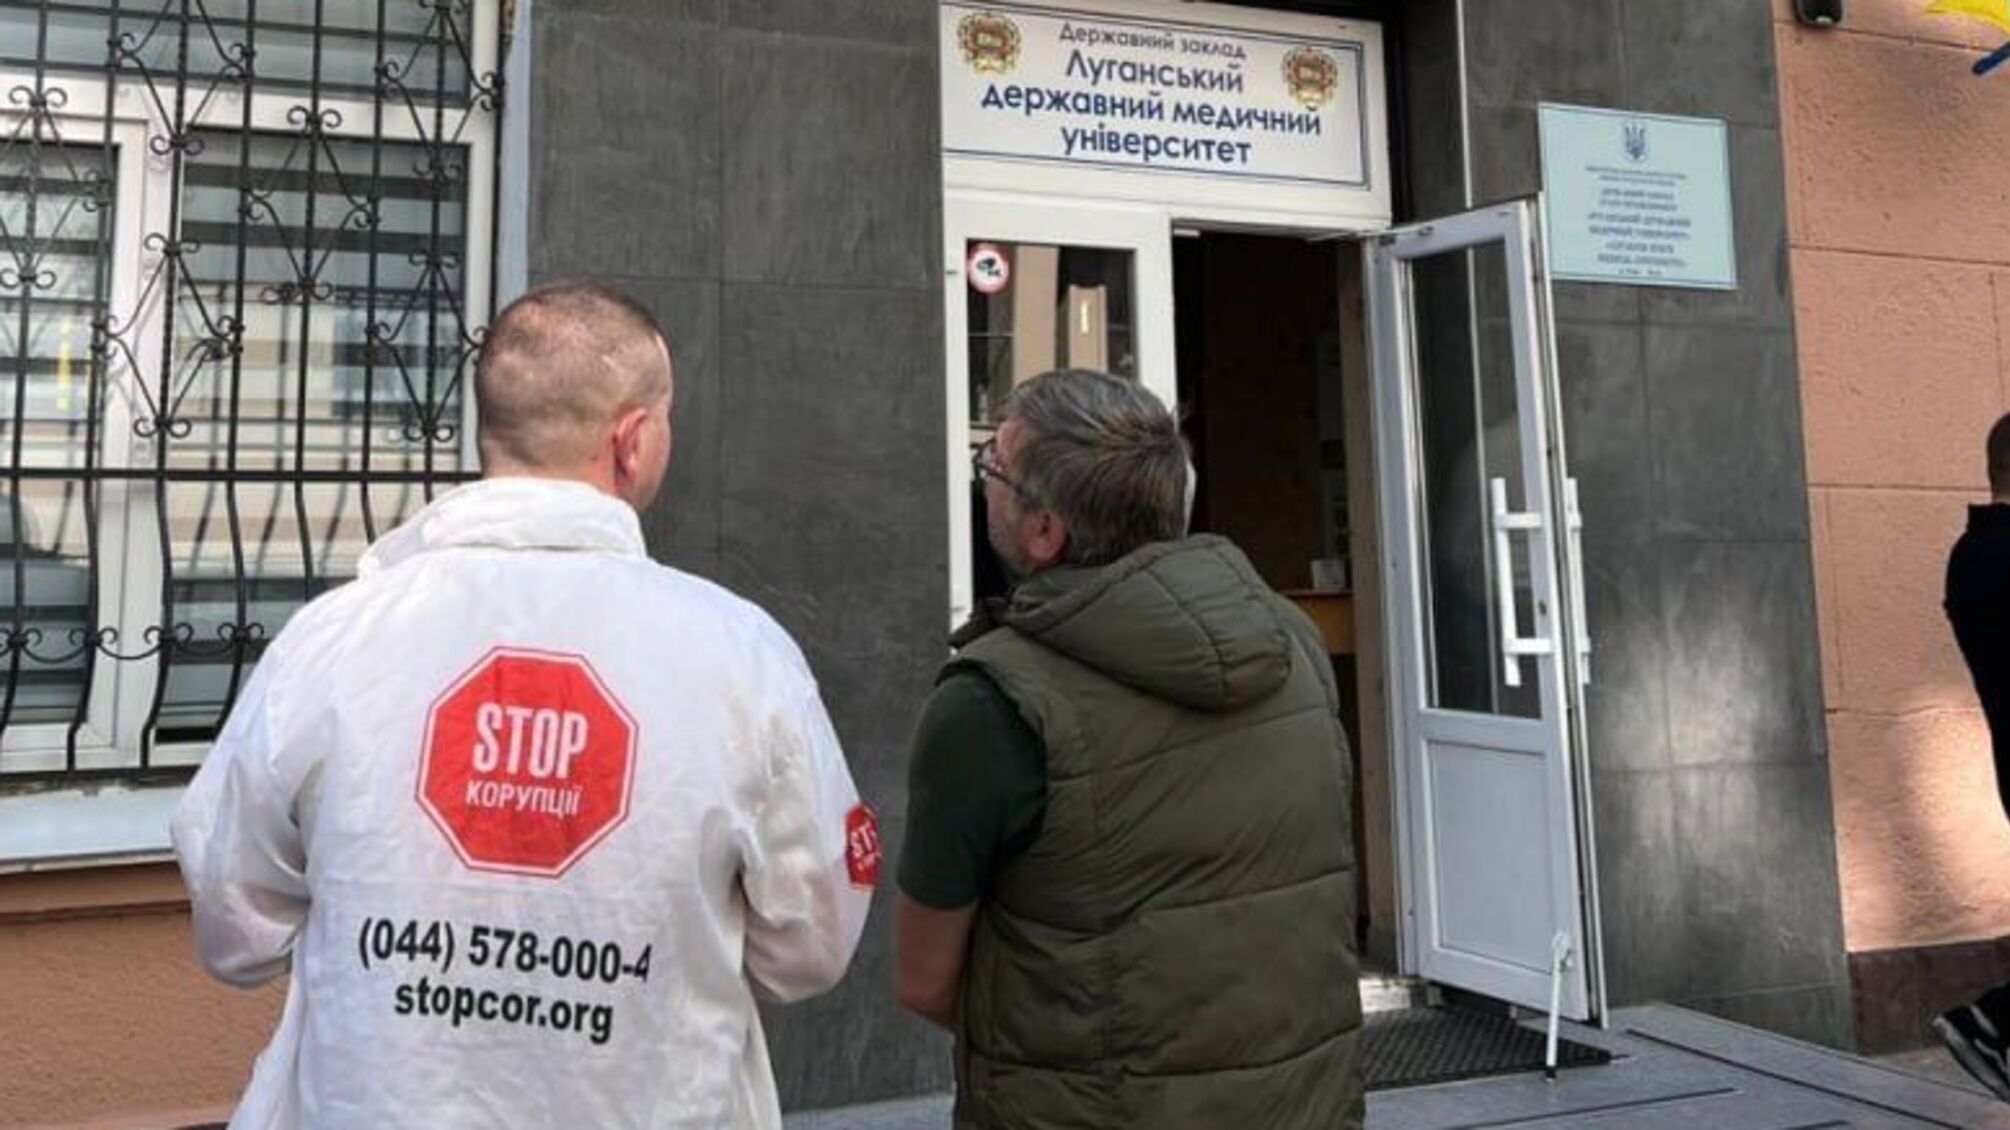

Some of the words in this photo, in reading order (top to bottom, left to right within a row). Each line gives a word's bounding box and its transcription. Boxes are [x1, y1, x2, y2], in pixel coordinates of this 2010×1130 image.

[1060, 22, 1175, 52] Державний
[1180, 36, 1247, 60] заклад
[1065, 50, 1244, 94] Луганський
[981, 82, 1165, 121] державний
[1171, 106, 1321, 136] медичний
[1061, 124, 1253, 164] університет
[471, 702, 588, 780] STOP
[465, 779, 584, 817] КОРУПЦІЇ
[359, 917, 455, 974] (044)
[467, 924, 653, 983] 578-000-4
[394, 976, 614, 1046] stopcor.org
